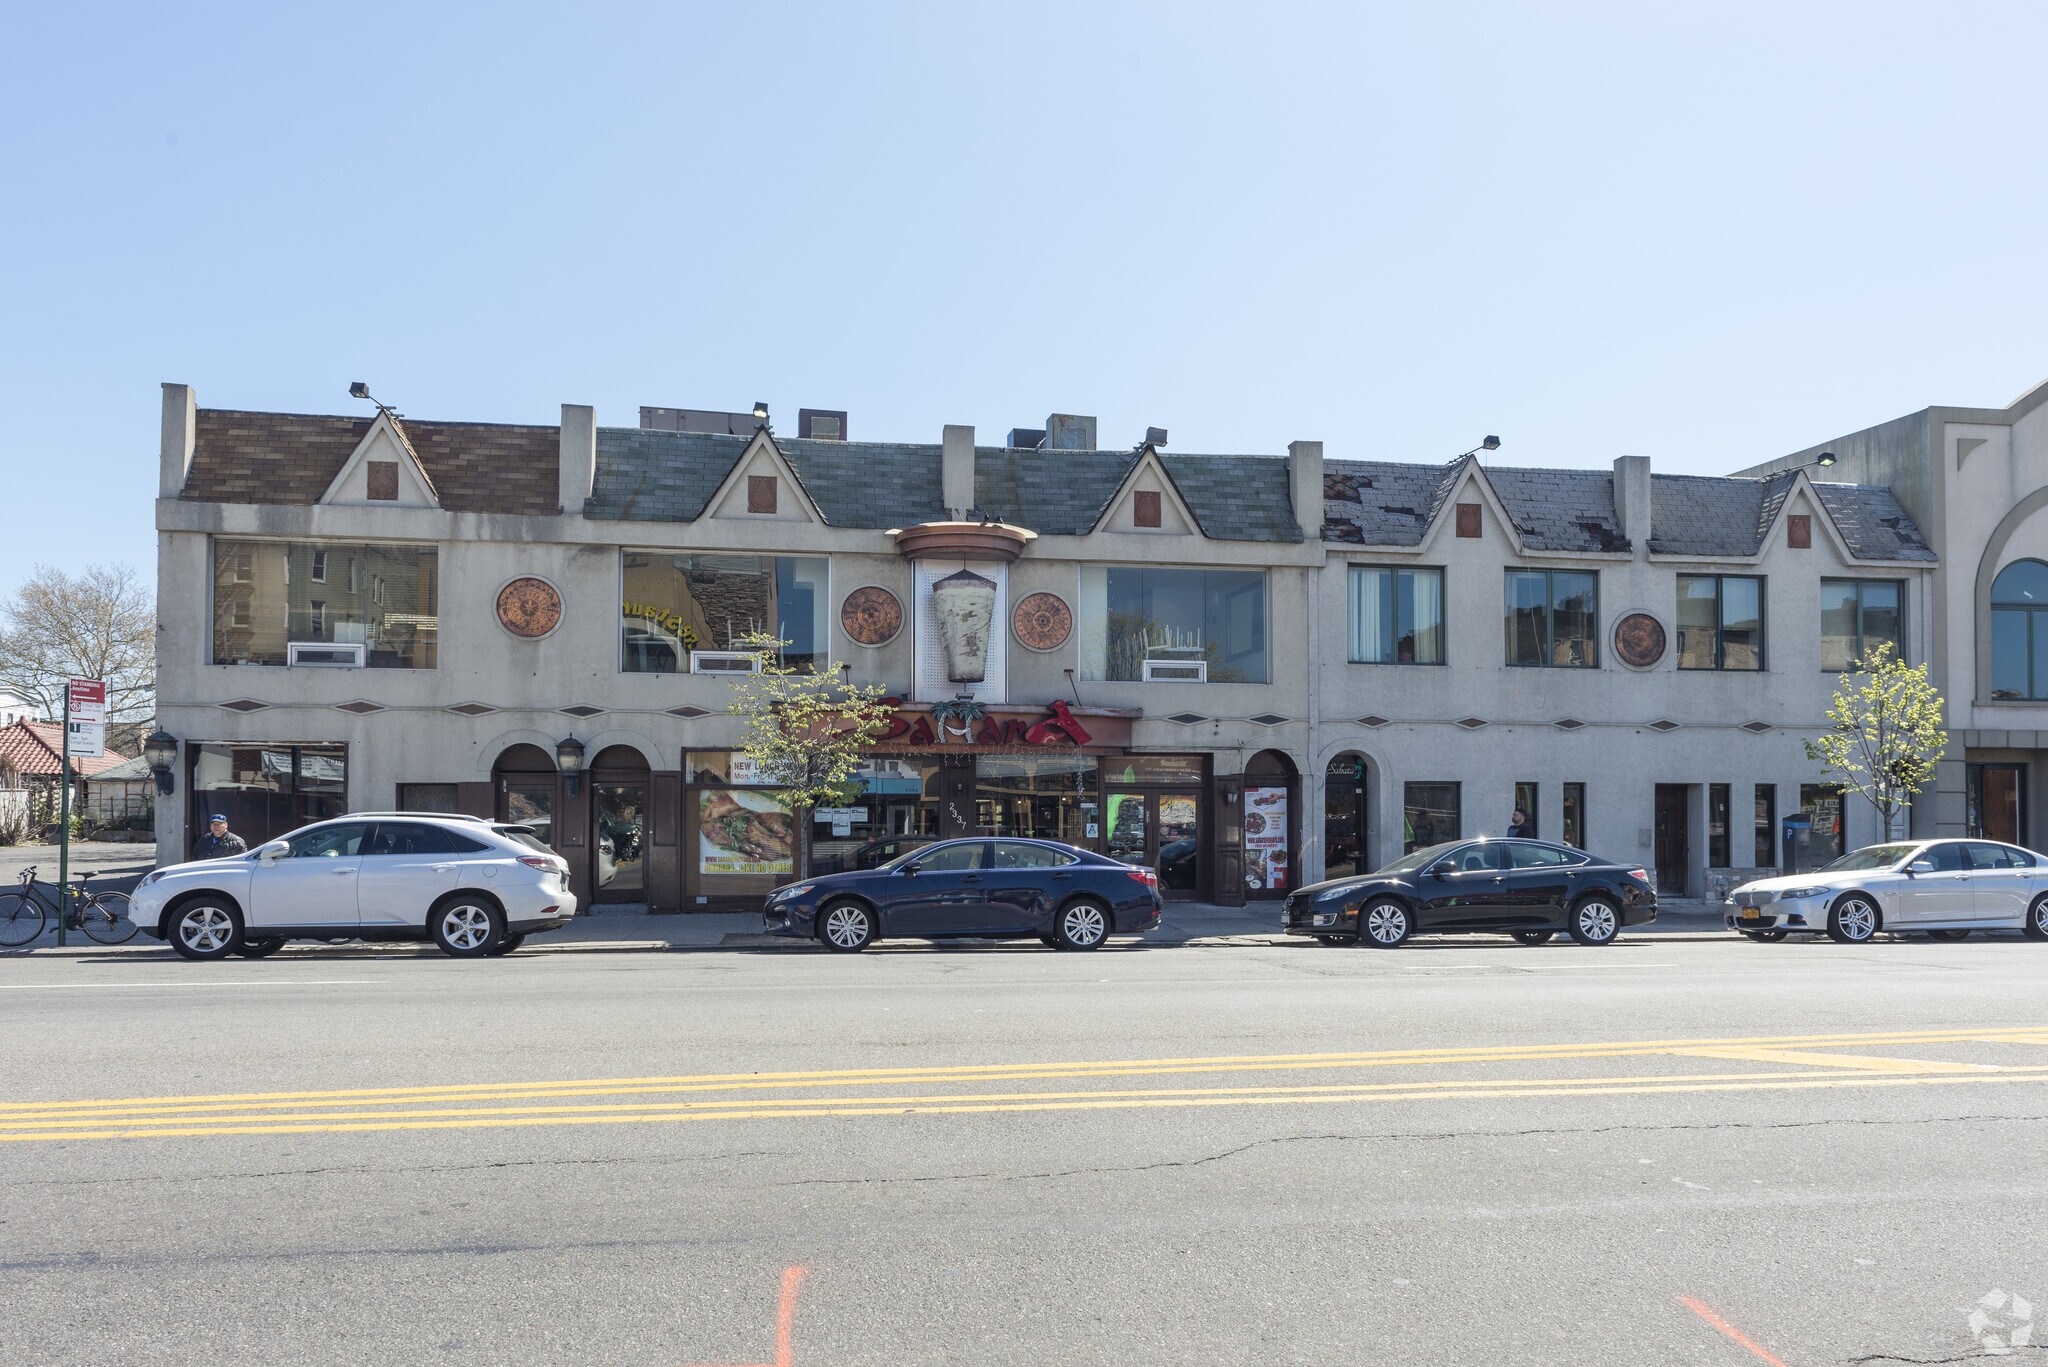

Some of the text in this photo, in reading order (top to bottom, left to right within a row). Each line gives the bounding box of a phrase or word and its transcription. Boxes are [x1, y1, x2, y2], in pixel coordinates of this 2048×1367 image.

[734, 762, 752, 770] NEW
[948, 802, 967, 830] 2337
[1088, 824, 1096, 835] A
[1787, 828, 1793, 839] P
[705, 863, 735, 872] SAHARA
[756, 863, 766, 872] NO
